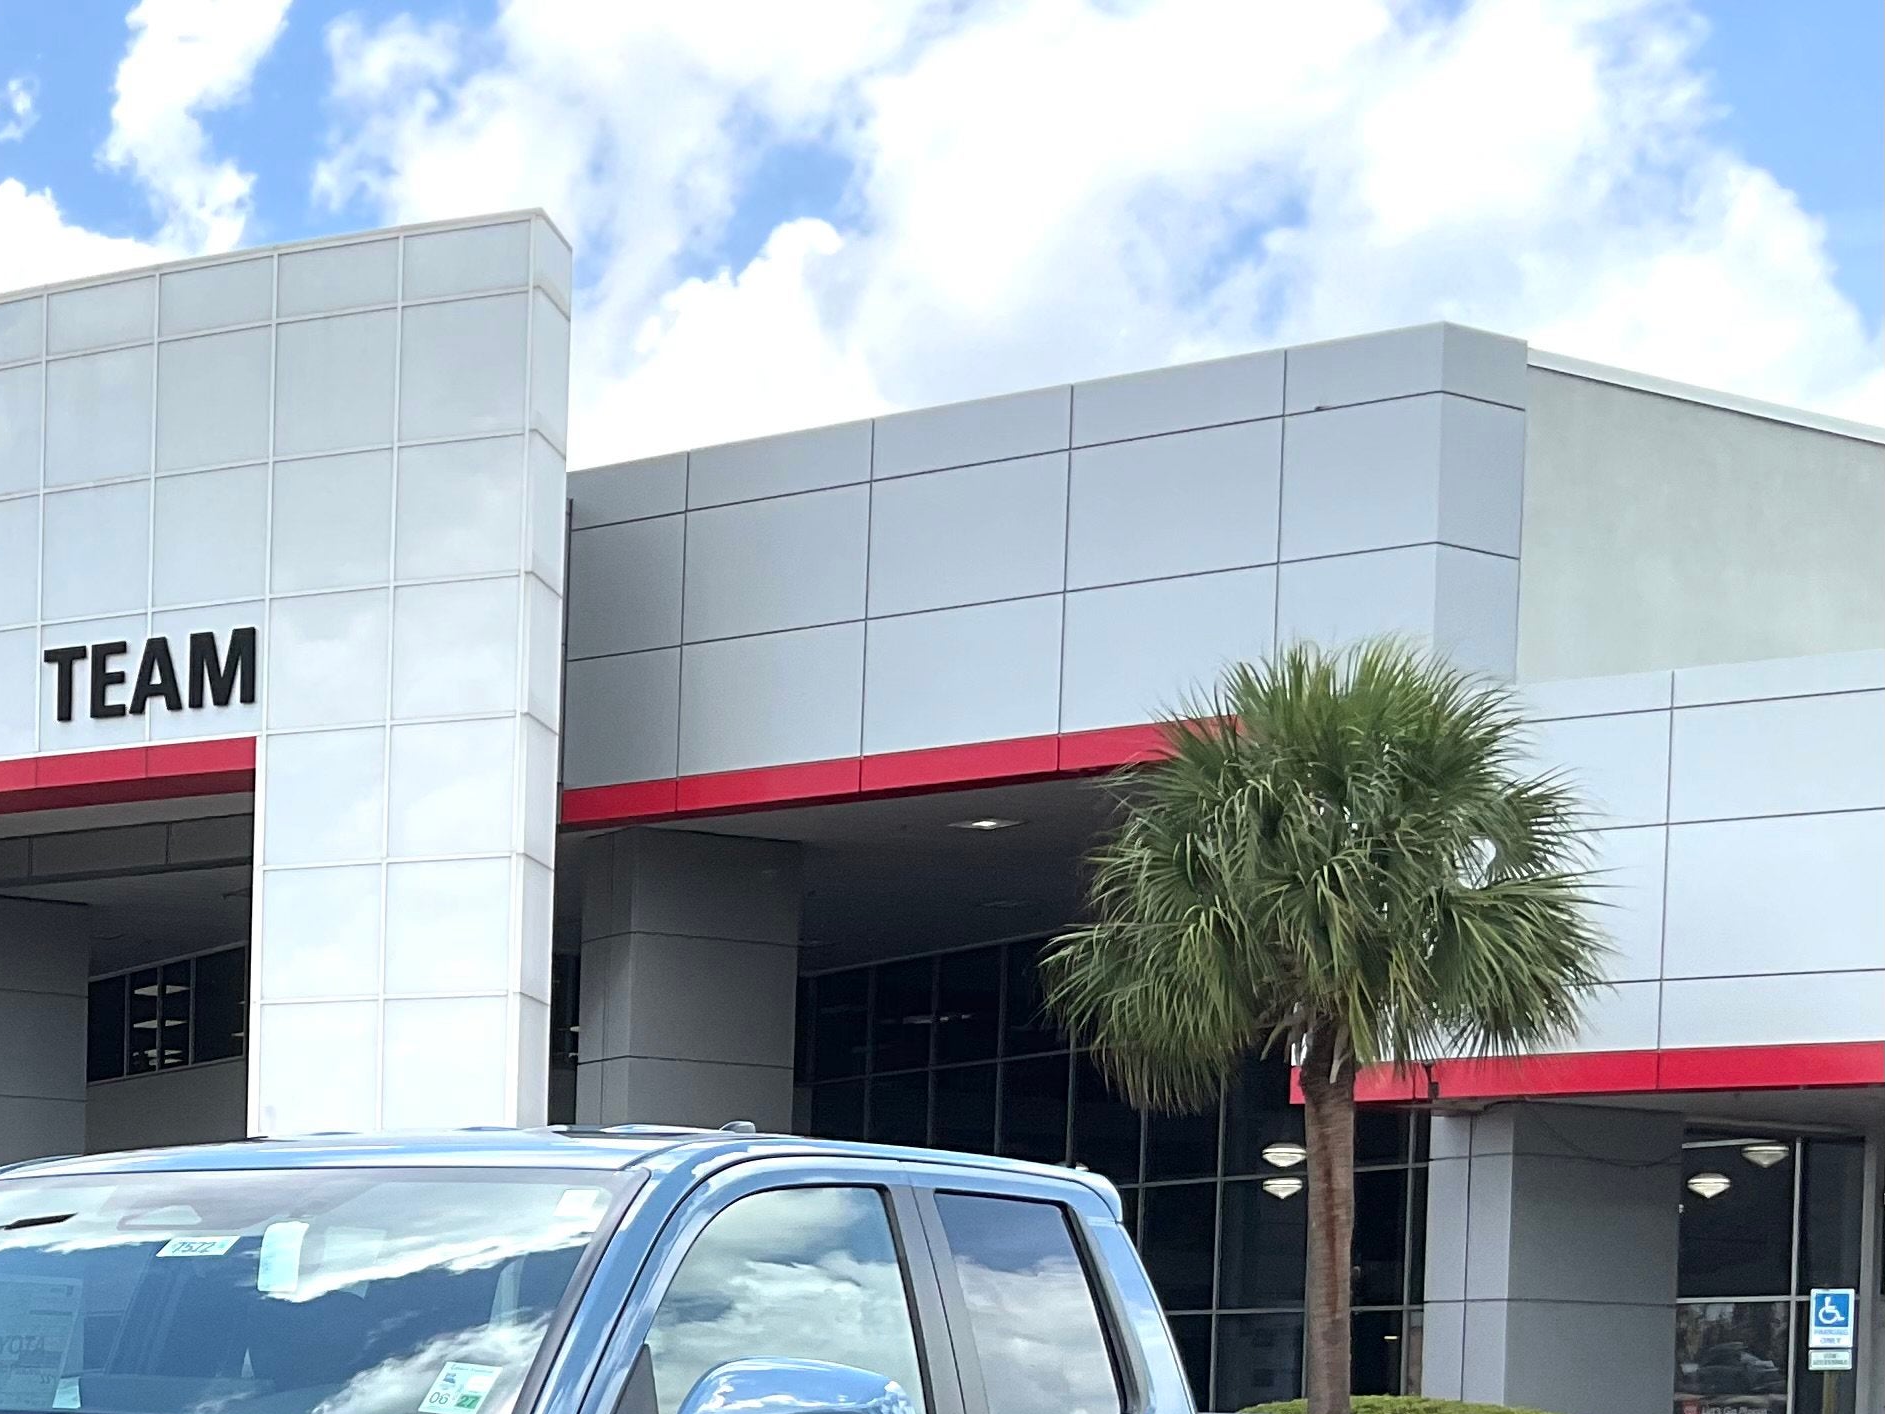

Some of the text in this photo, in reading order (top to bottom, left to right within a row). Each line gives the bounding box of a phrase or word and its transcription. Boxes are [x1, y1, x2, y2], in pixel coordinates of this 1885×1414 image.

[44, 626, 256, 722] TEAM
[429, 1392, 450, 1405] 06
[456, 1395, 482, 1409] 27
